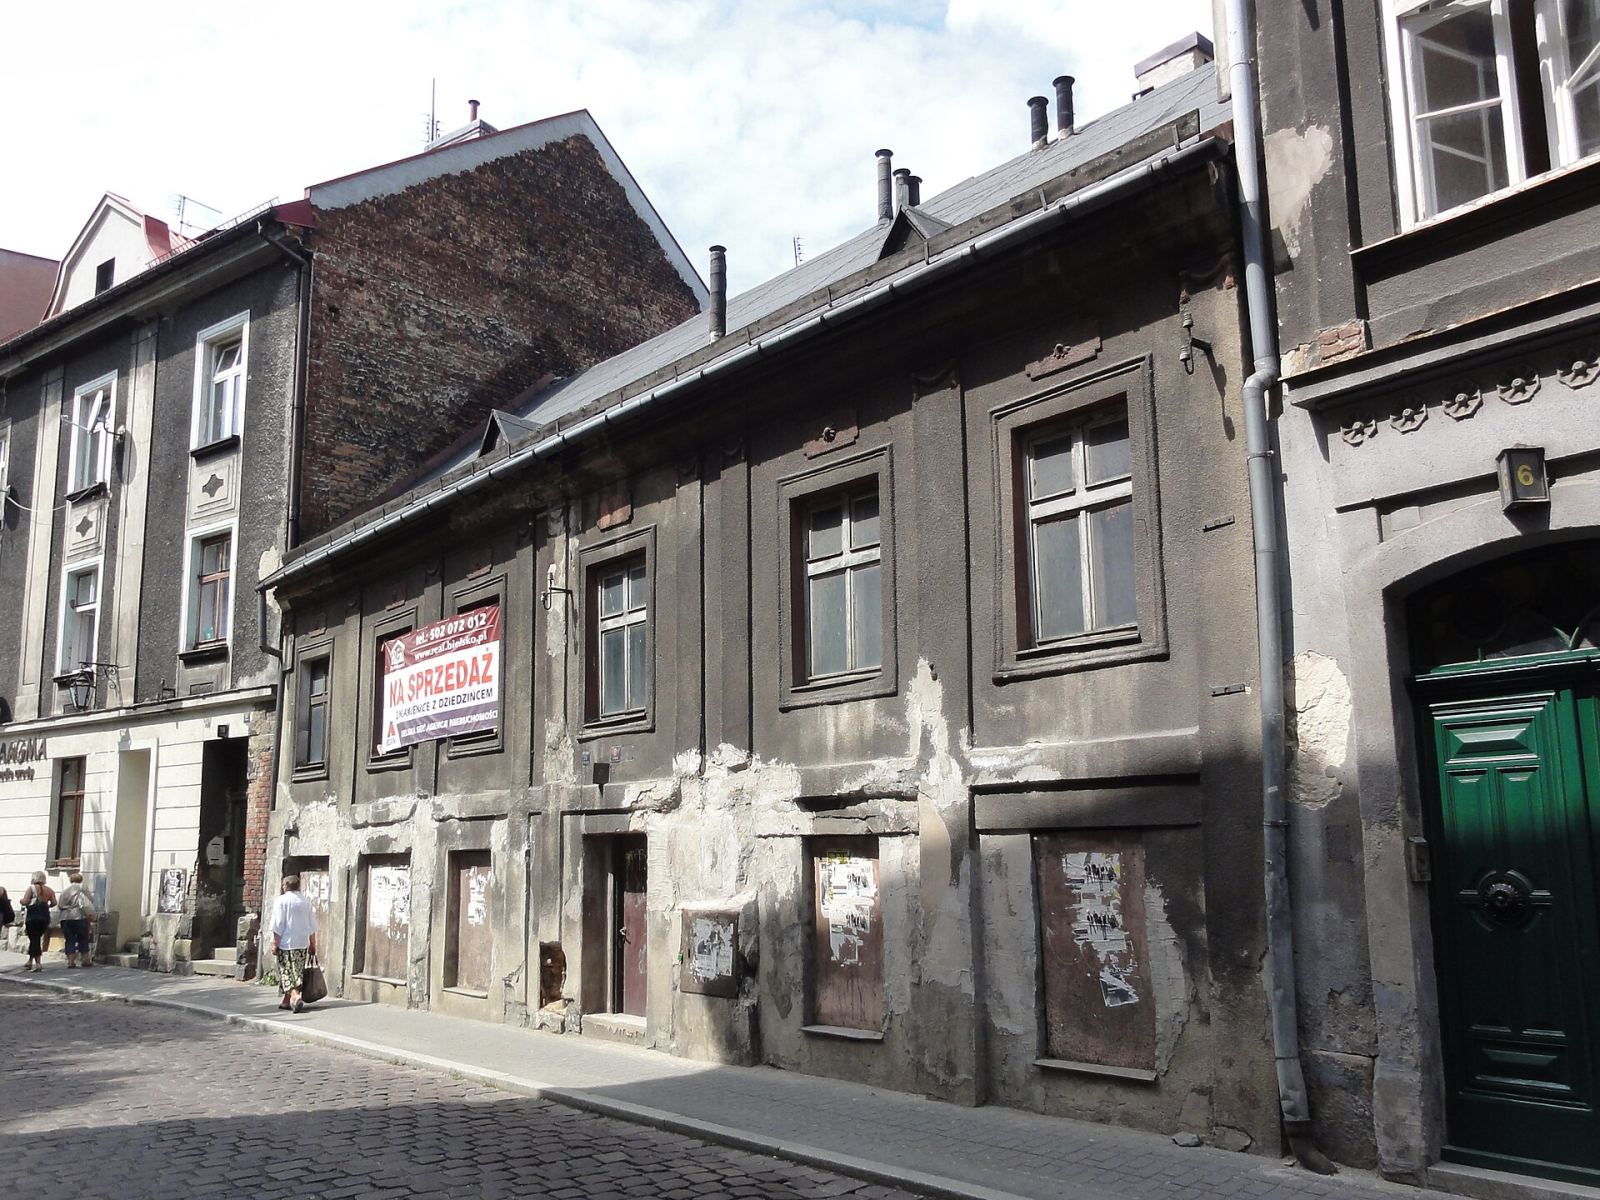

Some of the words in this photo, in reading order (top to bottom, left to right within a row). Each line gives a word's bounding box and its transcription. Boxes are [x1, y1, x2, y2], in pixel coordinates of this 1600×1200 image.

[1517, 464, 1534, 486] 6
[430, 624, 446, 641] 502
[447, 619, 465, 635] 072
[467, 612, 487, 630] 012
[389, 678, 404, 708] NA
